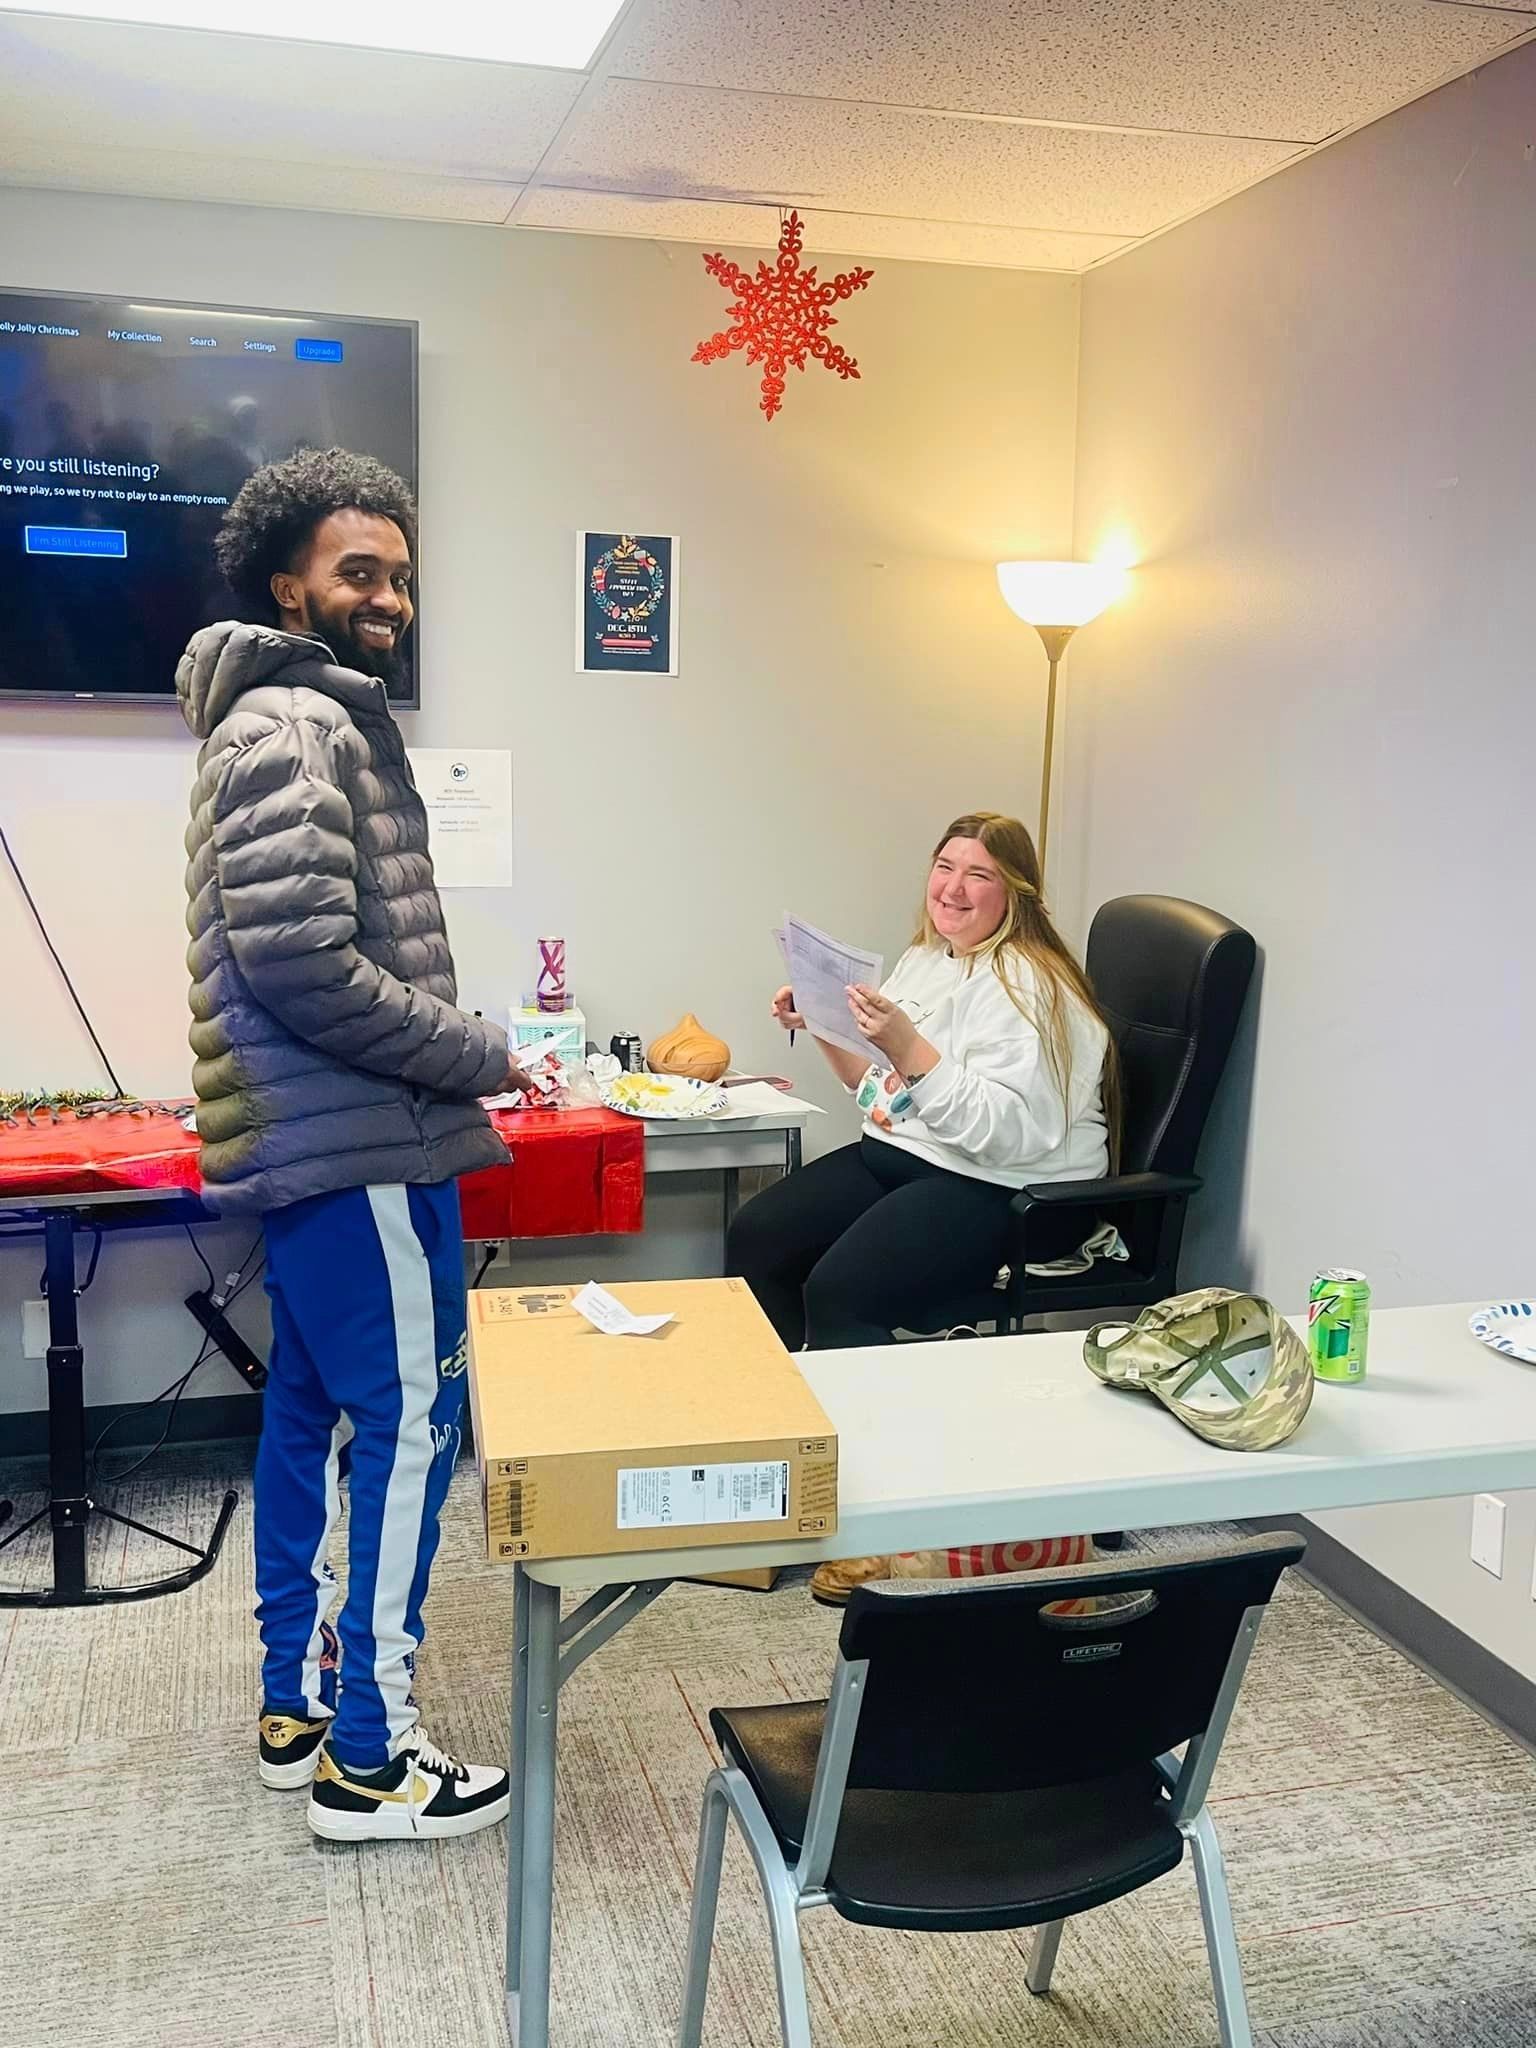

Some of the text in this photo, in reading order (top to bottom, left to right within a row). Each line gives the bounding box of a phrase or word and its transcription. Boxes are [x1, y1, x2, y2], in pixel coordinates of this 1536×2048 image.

[17, 323, 37, 335] Jolly
[38, 325, 80, 337] Christmas
[107, 330, 162, 342] My Collection
[189, 336, 217, 347] Search
[243, 340, 277, 353] Settings
[303, 345, 336, 356] Upgrade
[16, 458, 45, 474] you
[49, 458, 80, 474] still
[83, 458, 160, 481] listening?
[13, 485, 28, 494] we
[30, 484, 53, 497] play,
[54, 487, 65, 496] so
[66, 487, 81, 497] we
[82, 488, 96, 499] try
[99, 489, 114, 499] not
[115, 490, 125, 499] to
[127, 490, 146, 502] play
[148, 492, 158, 501] to
[160, 493, 171, 502] an
[173, 494, 201, 505] empty
[203, 496, 230, 505] room.
[51, 537, 72, 547] Still
[74, 538, 119, 551] Listening
